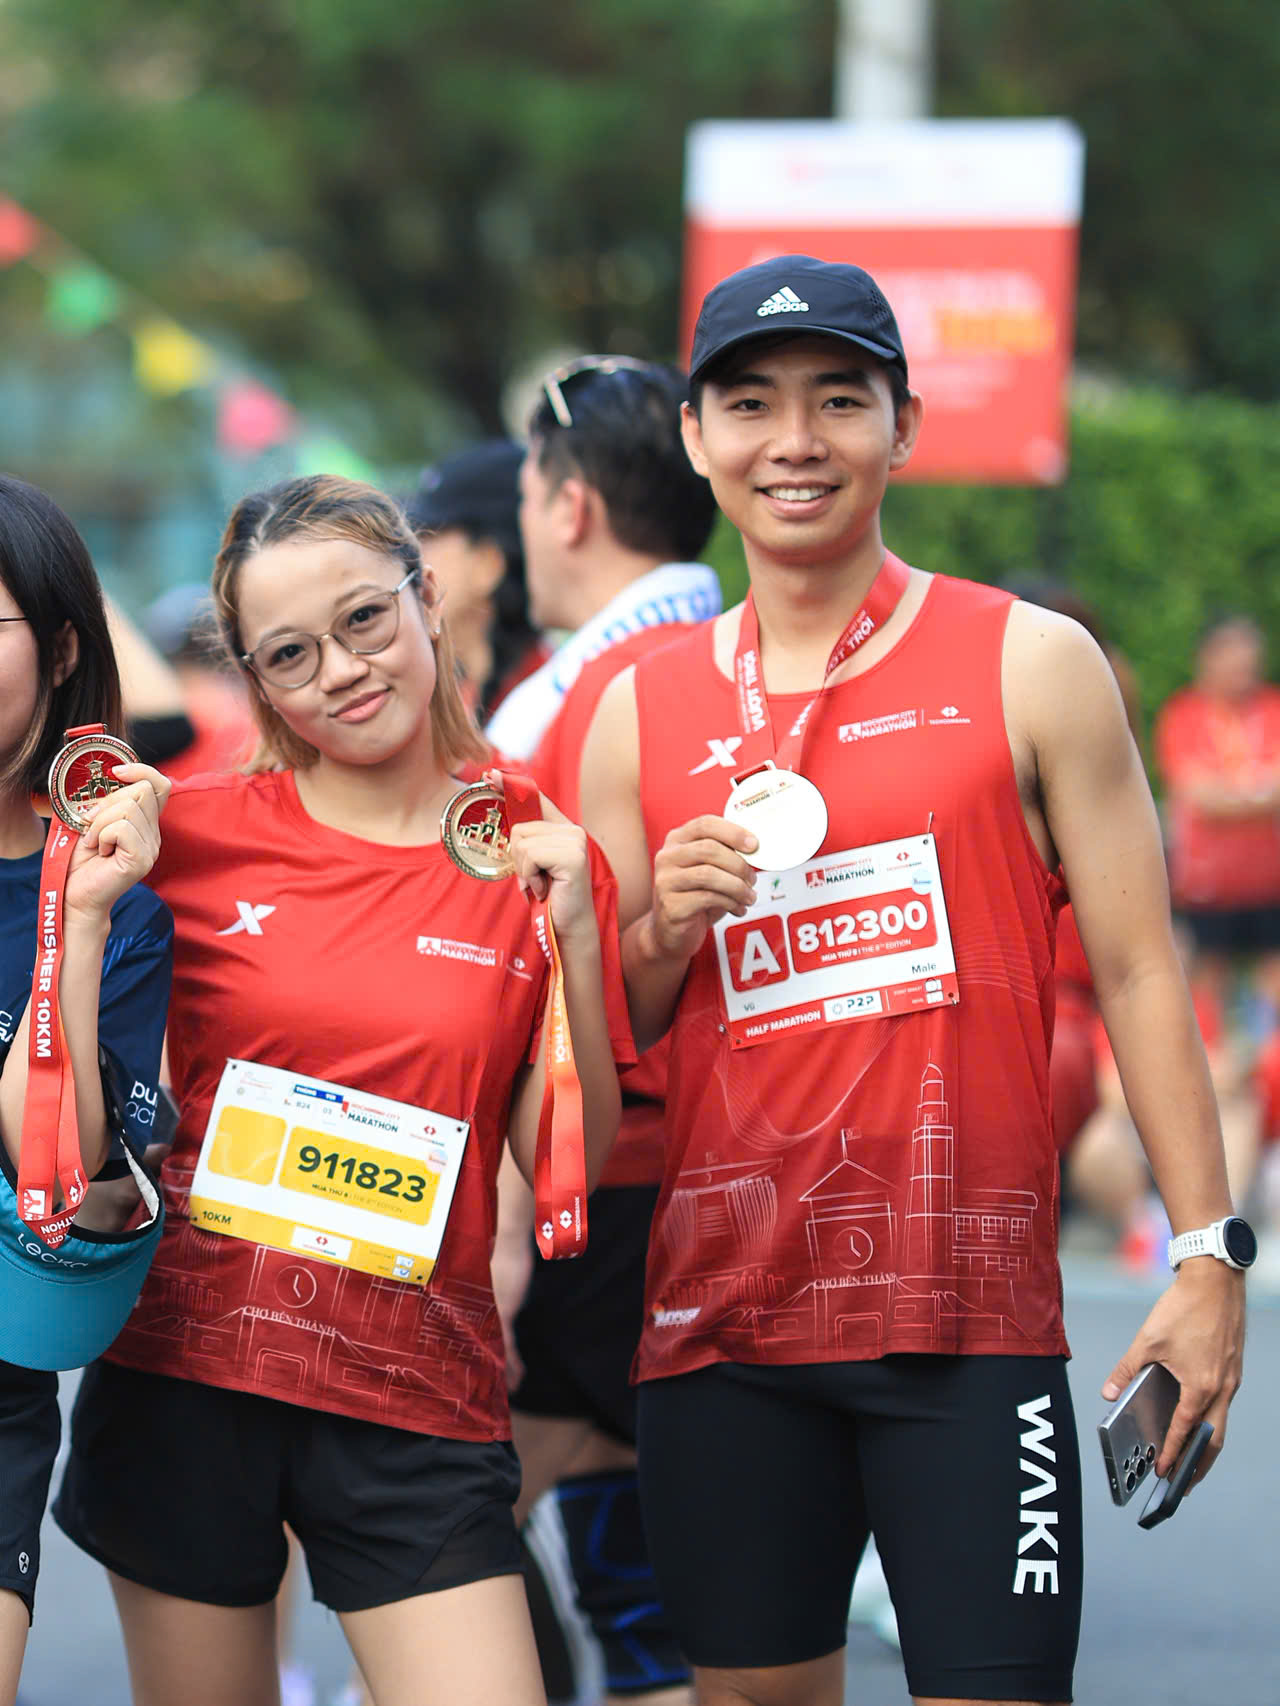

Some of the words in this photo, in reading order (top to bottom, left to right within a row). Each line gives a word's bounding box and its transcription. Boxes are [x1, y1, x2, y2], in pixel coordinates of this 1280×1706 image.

[757, 301, 809, 317] adidas
[861, 717, 917, 739] MARATHON
[826, 868, 875, 885] MARATHON
[797, 899, 928, 954] 812300
[38, 890, 57, 993] FINISHER
[885, 938, 911, 949] EDITION
[441, 949, 497, 967] MARATHON
[740, 928, 781, 982] A
[911, 963, 937, 974] Male
[36, 997, 52, 1058] 10KM
[746, 1023, 770, 1038] HALF
[770, 1010, 821, 1031] MARATHON
[347, 1112, 399, 1133] MARATHON
[298, 1145, 428, 1203] 911823
[202, 1210, 232, 1225] 10KM
[1013, 1394, 1059, 1595] WAKE
